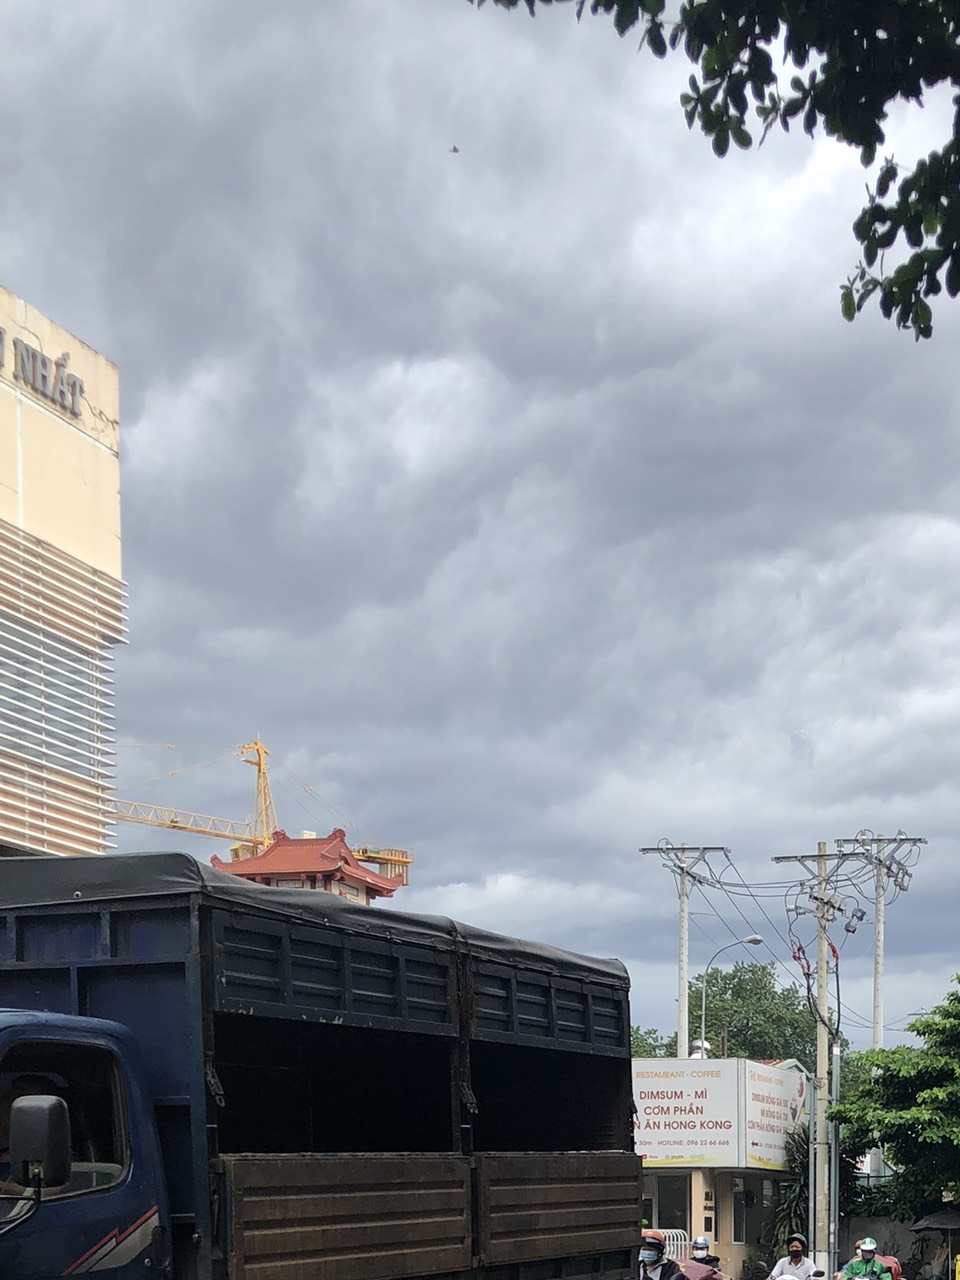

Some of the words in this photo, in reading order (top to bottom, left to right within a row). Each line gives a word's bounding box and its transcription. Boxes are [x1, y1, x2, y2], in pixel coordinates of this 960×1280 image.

[690, 1070, 721, 1078] COFFEE
[639, 1090, 684, 1100] DIMSUM
[694, 1088, 707, 1100] MÌ
[643, 1105, 670, 1116] CƠM
[644, 1119, 661, 1130] ĂN
[664, 1120, 697, 1130] HONG
[700, 1120, 733, 1130] KONG
